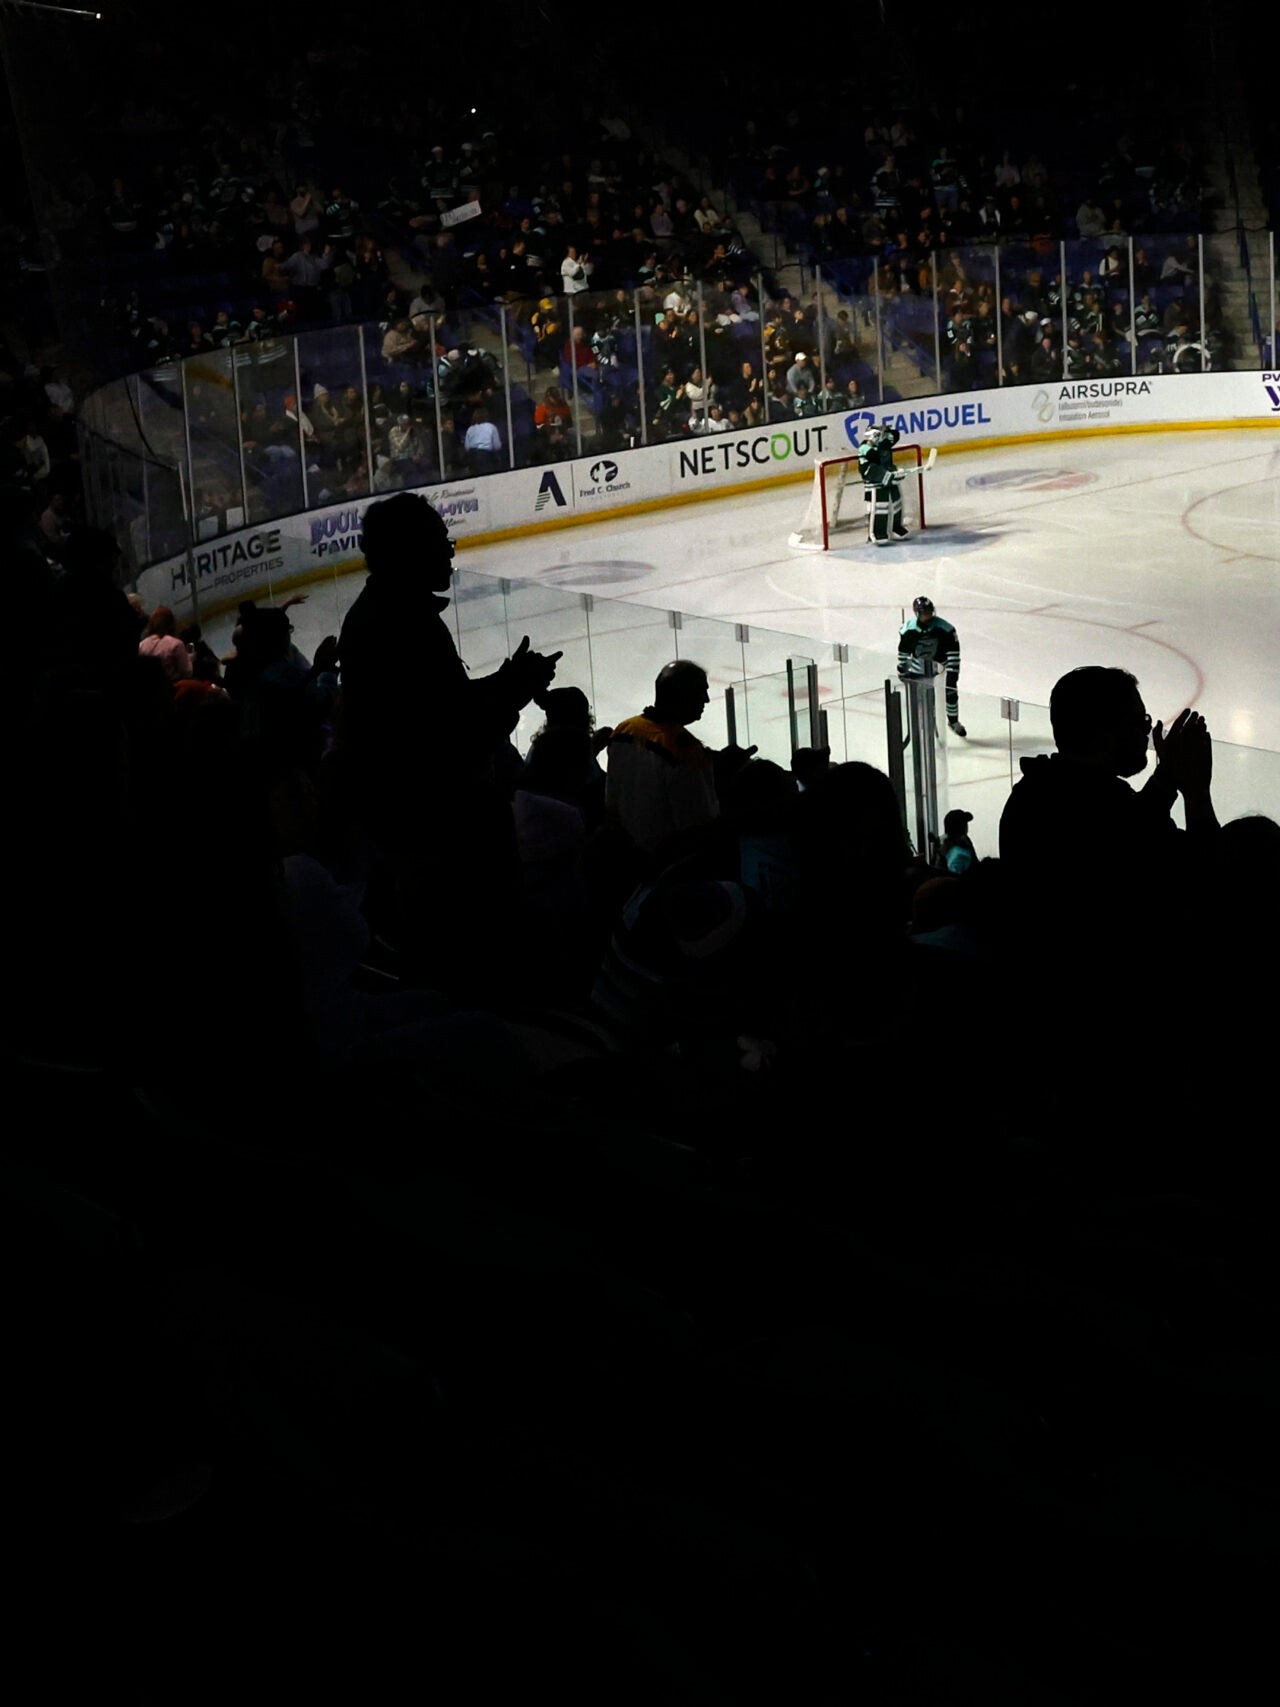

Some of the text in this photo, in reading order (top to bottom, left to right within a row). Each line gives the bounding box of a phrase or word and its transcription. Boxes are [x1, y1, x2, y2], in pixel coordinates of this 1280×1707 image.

[1059, 381, 1151, 400] AIRSUPRA
[680, 426, 828, 478] NETSCOUT
[171, 529, 282, 591] HRITAGE
